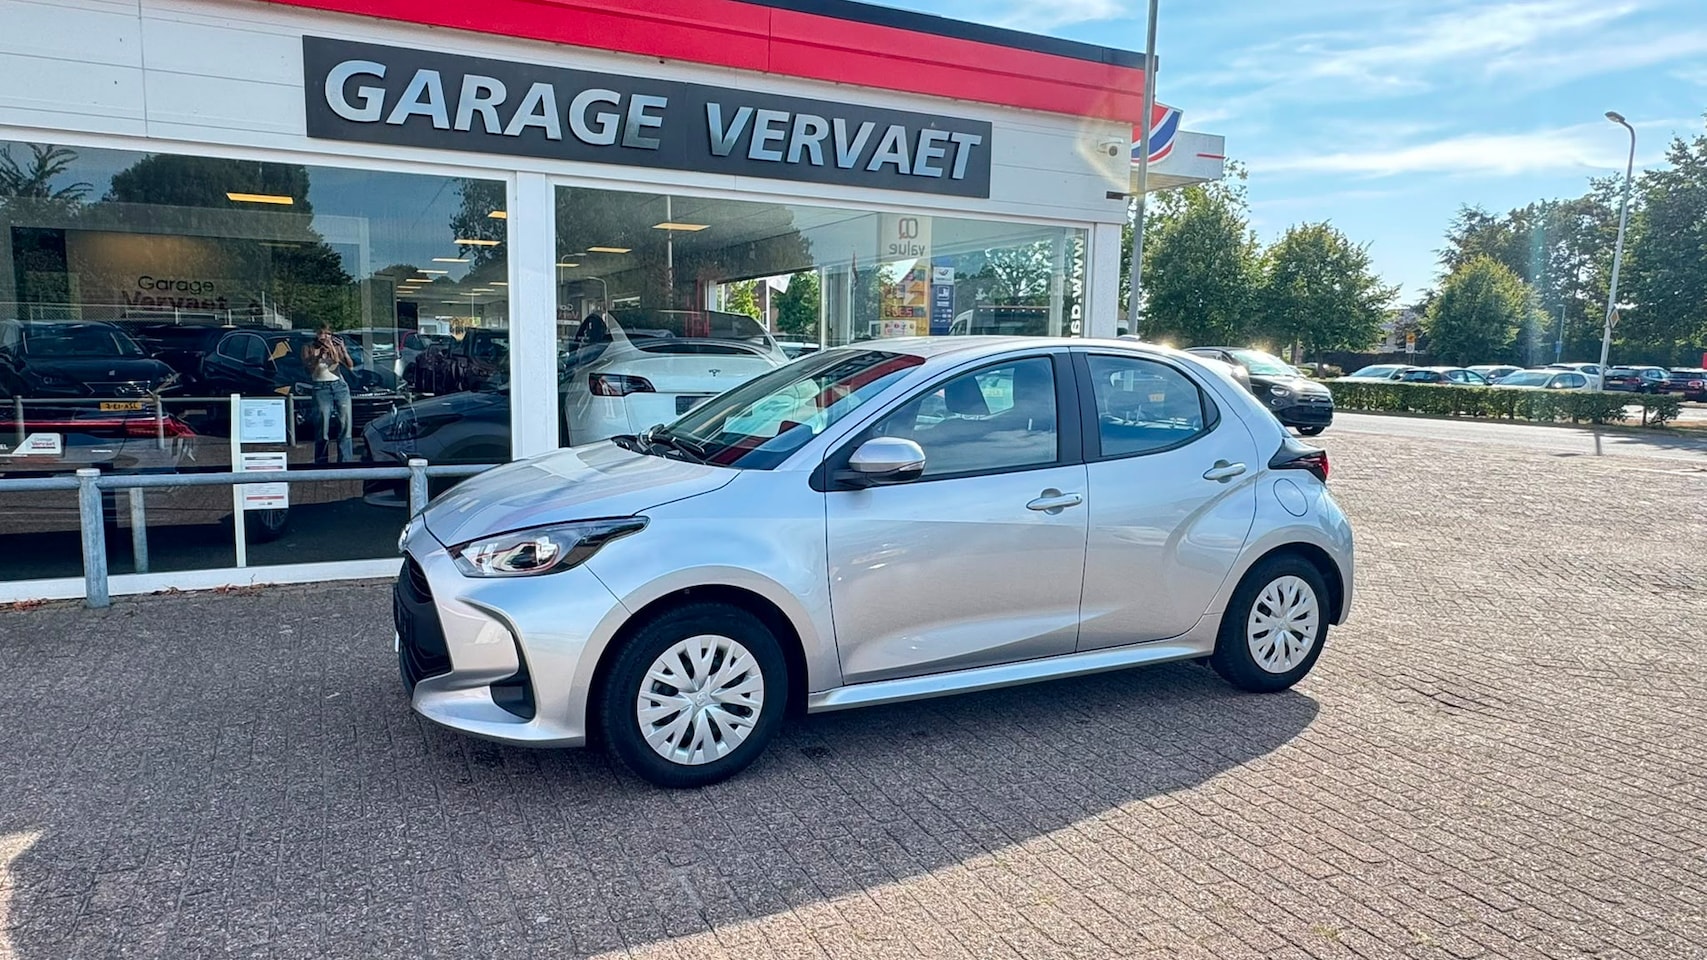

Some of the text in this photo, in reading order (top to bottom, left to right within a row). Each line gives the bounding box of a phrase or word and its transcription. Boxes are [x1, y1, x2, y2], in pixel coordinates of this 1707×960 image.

[324, 59, 982, 180] GARAGE VERVAET
[137, 275, 214, 295] Garage
